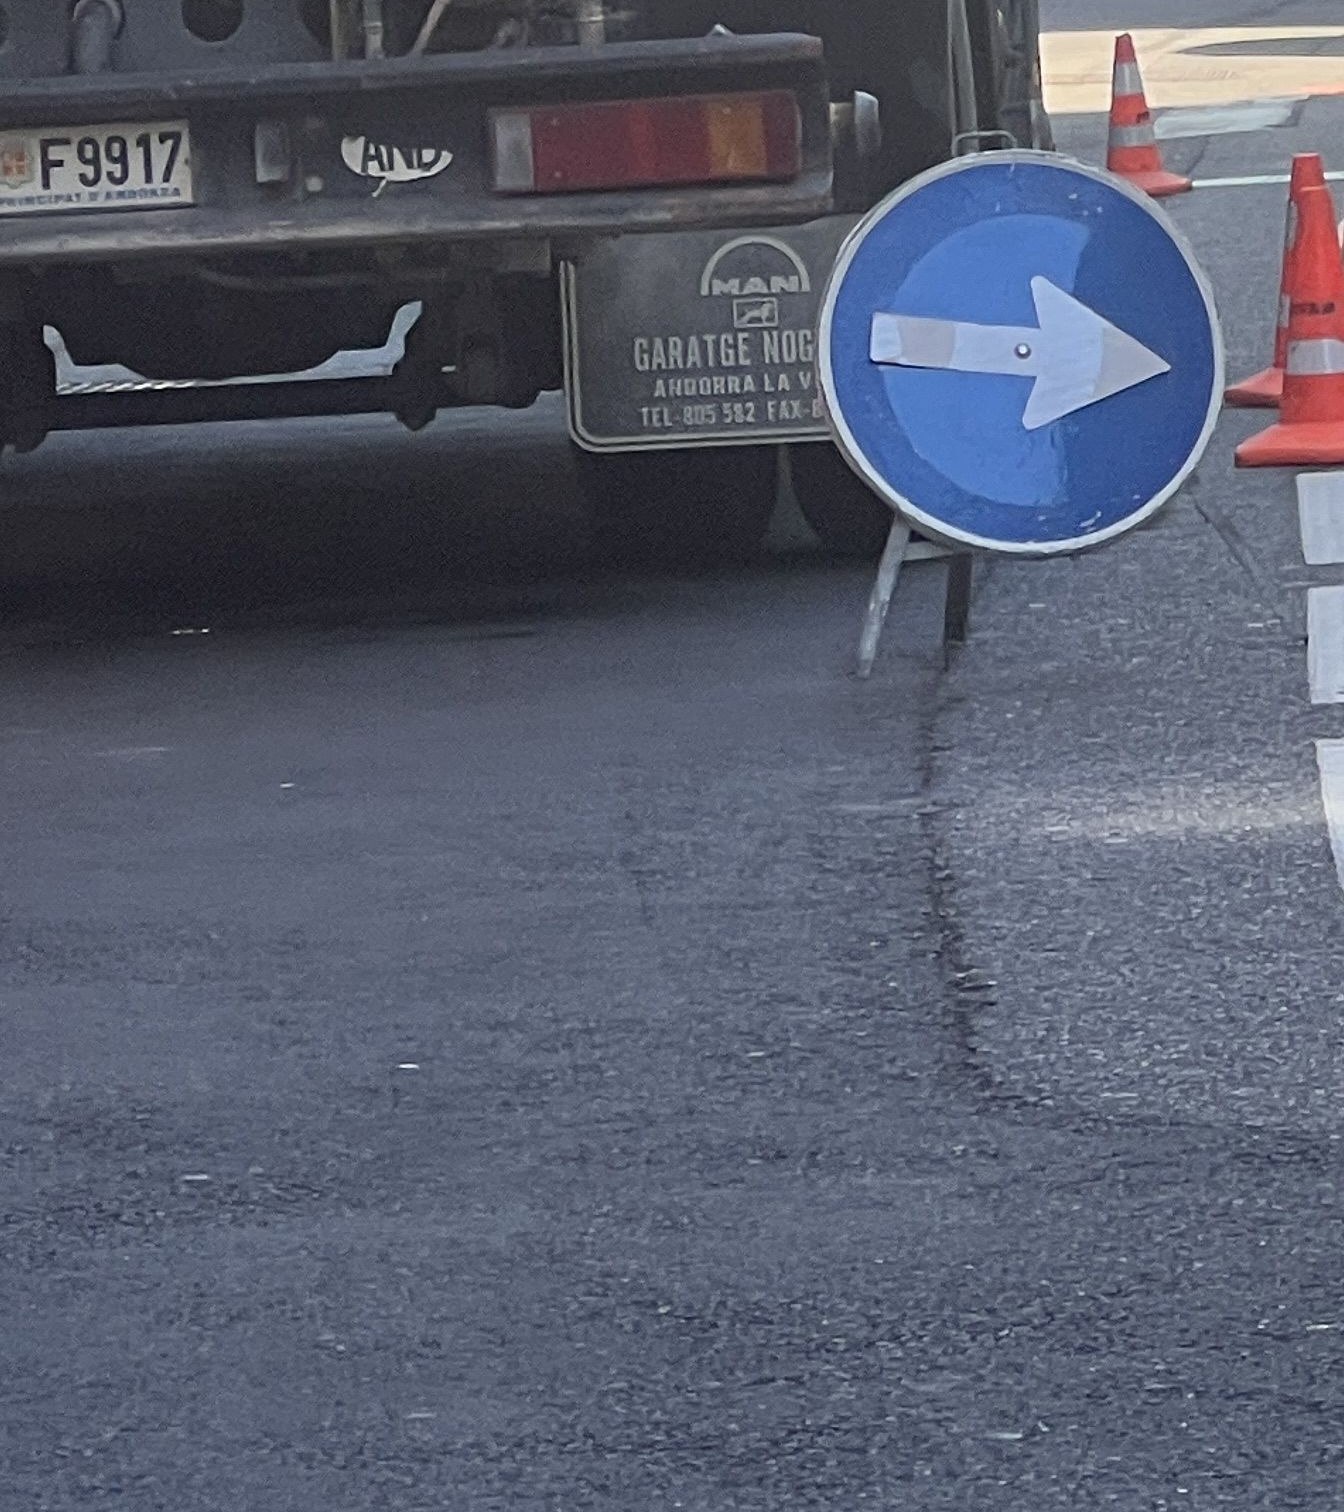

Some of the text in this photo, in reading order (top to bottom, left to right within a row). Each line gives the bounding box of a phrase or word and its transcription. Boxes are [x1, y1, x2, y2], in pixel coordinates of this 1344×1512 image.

[40, 131, 182, 190] F9917
[361, 135, 443, 173] AND
[712, 275, 799, 295] MAN
[633, 328, 814, 372] GARATGE NOG
[653, 370, 814, 399] ANDORRA LA V
